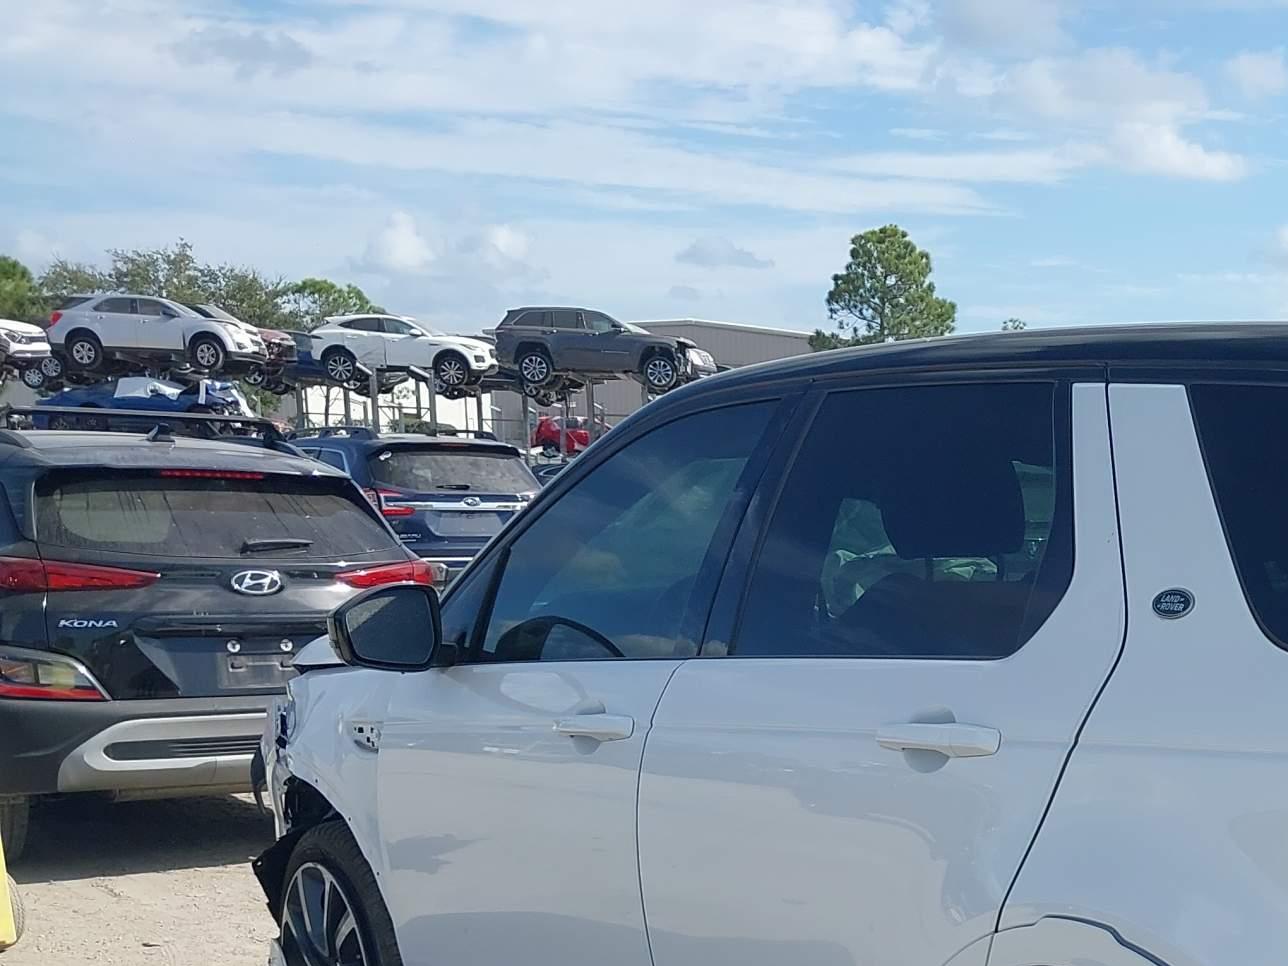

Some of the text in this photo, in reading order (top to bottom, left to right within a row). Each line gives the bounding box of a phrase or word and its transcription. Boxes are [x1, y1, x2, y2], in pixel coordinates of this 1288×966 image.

[1160, 593, 1181, 603] LAND
[1159, 602, 1185, 611] ROVER
[57, 618, 119, 628] KONA
